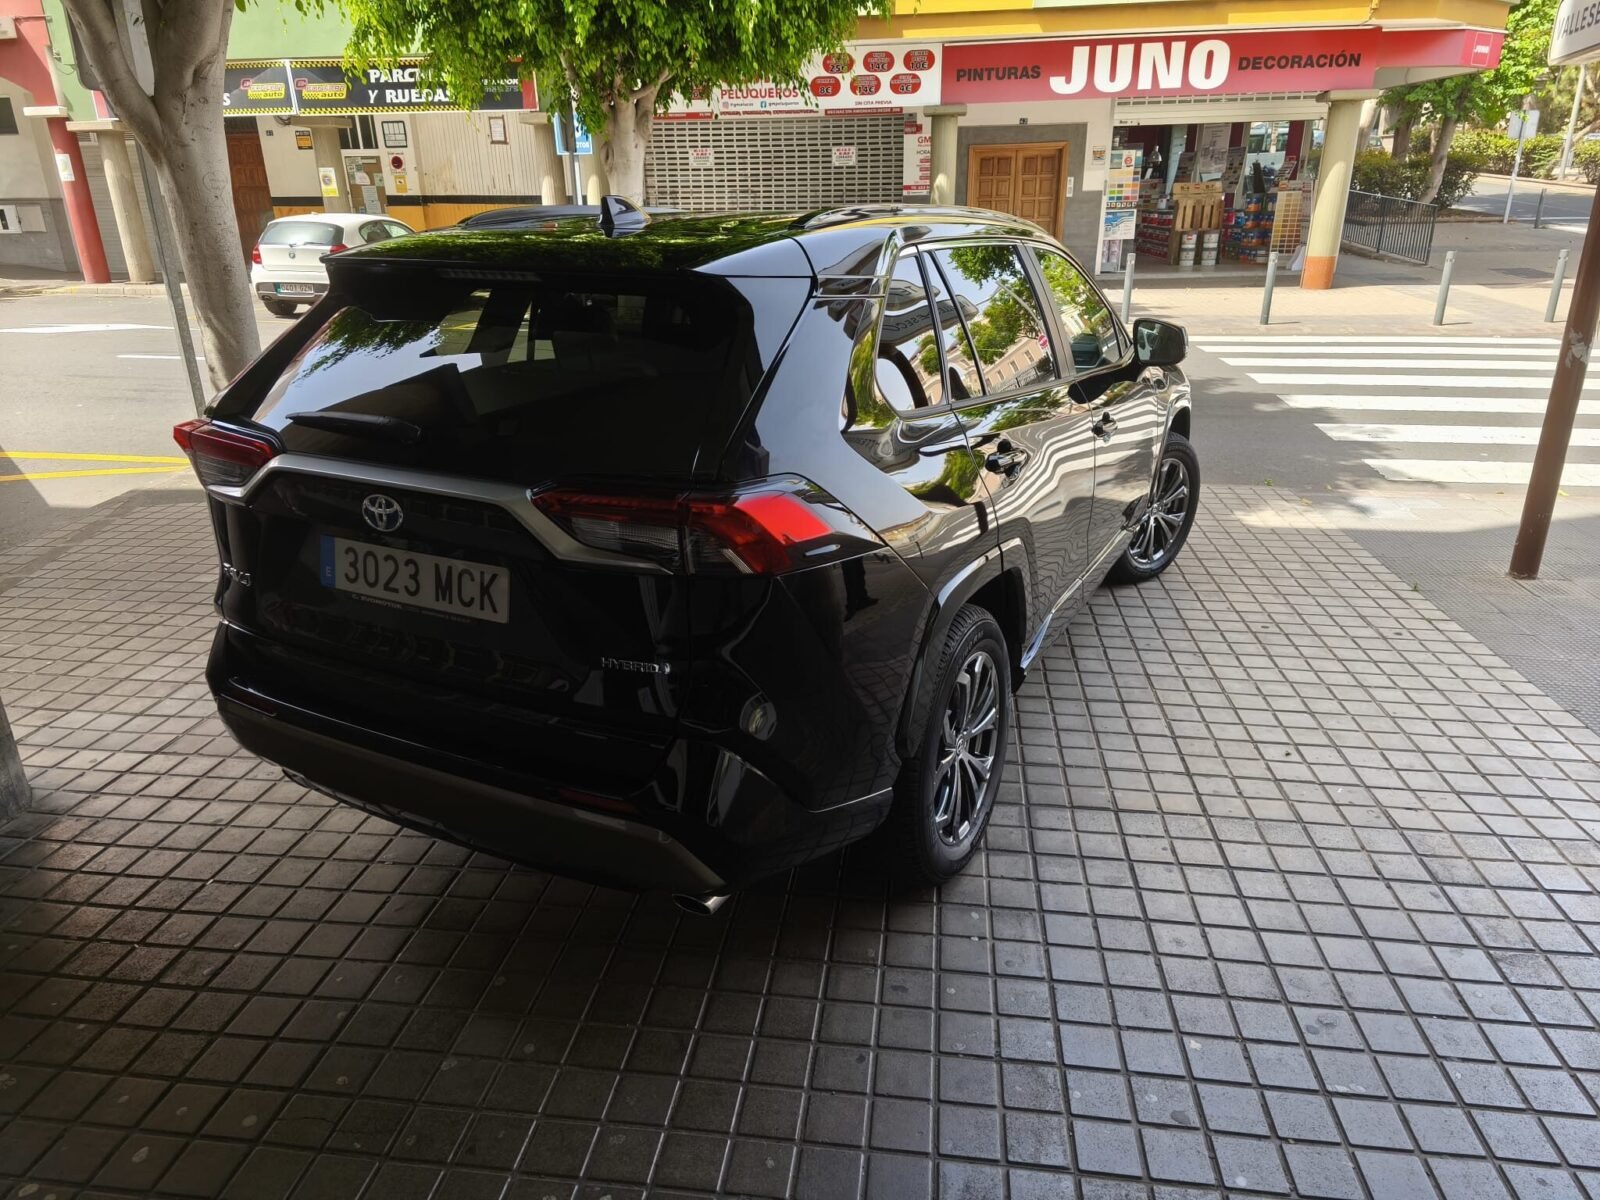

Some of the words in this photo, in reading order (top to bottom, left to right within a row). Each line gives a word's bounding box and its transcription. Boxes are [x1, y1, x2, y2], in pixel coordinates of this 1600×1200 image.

[956, 64, 1041, 82] PINTURAS
[1049, 39, 1231, 95] JUNO
[1237, 49, 1362, 71] DECORACIÓN
[368, 89, 379, 103] Y
[720, 88, 799, 100] PELUQUEROS
[325, 566, 332, 577] E
[343, 546, 420, 597] 3023
[434, 562, 499, 614] MCK
[600, 656, 660, 673] HYBRID
